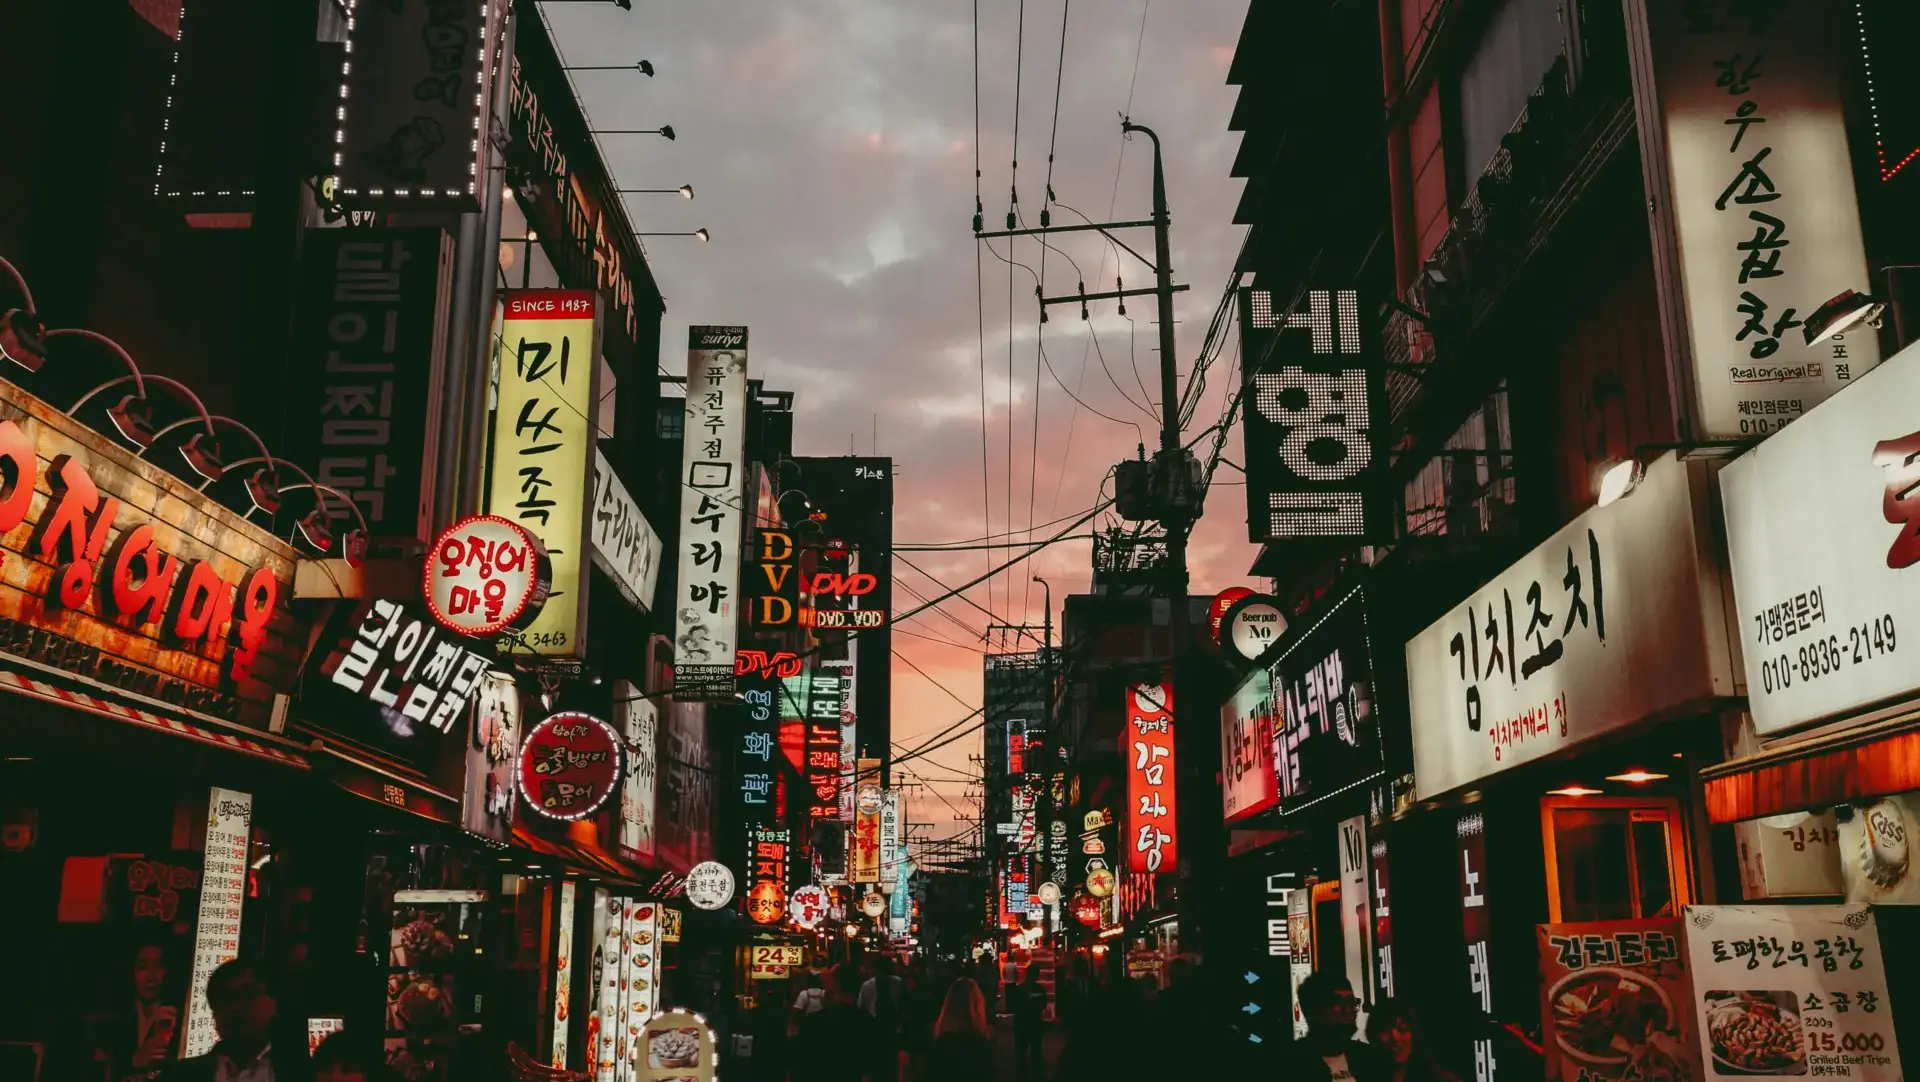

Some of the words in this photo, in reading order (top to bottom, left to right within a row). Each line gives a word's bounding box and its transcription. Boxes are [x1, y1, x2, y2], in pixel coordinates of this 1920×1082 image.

[512, 300, 555, 312] SINCE
[560, 299, 590, 312] 1987
[701, 332, 743, 347] suriya
[317, 241, 410, 523] 달인찜닭
[1731, 367, 1757, 379] Real
[702, 366, 727, 458] 퓨전주점
[1738, 401, 1803, 415] 체인점문의
[439, 536, 527, 578] 오징어
[690, 496, 728, 614] 수리야
[760, 532, 793, 624] DVD
[812, 573, 877, 596] DVD
[449, 579, 506, 623] 마을
[1242, 613, 1260, 622] Beer
[1262, 613, 1277, 622] pub
[1754, 585, 1827, 646] 가맹점문의
[533, 630, 567, 647] 3463
[1249, 625, 1271, 639] No
[1449, 527, 1607, 733] 김치조치
[332, 599, 488, 735] 달인찜닭
[736, 650, 803, 680] DVD
[1761, 612, 1898, 696] 010-8936-2149
[1489, 707, 1550, 763] 김치찌개의
[1554, 691, 1568, 737] 집
[1136, 742, 1171, 873] 감자탕
[756, 831, 786, 842] 영등포
[689, 879, 726, 891] 퓨전주점
[758, 947, 784, 963] 24
[1808, 1031, 1885, 1053] 15,000
[1809, 1054, 1840, 1065] Grilled
[1842, 1054, 1864, 1065] Beef
[1868, 1054, 1891, 1067] Tripe
